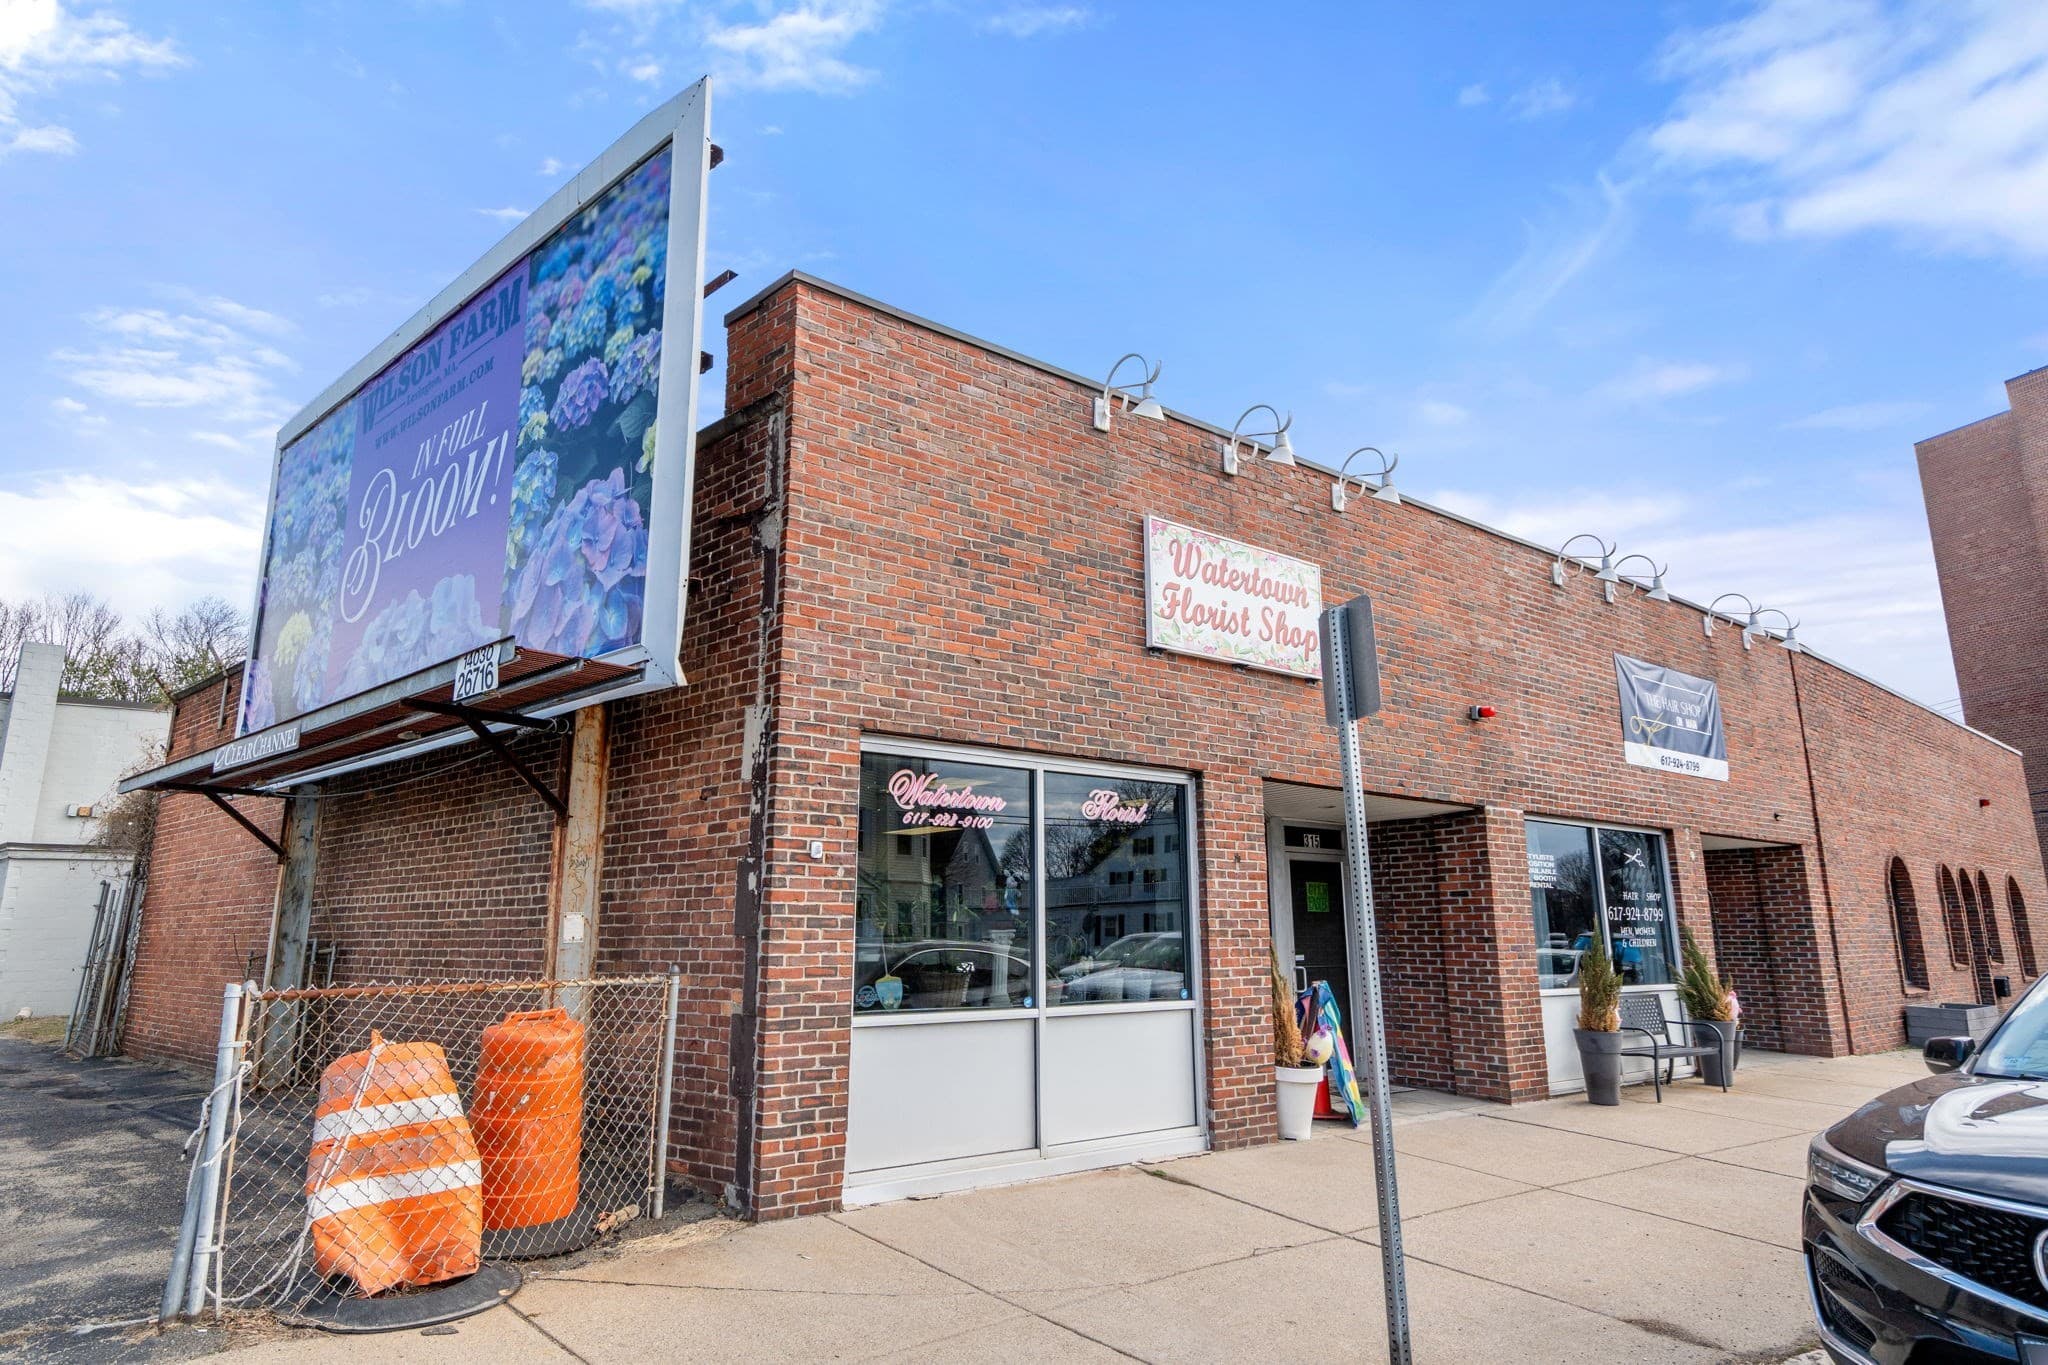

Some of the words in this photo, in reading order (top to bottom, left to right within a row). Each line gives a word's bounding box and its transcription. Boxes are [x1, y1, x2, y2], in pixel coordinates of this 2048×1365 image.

[362, 337, 444, 434] WILSON
[448, 275, 524, 361] FARM
[375, 356, 495, 449] WWW.WILSONFARM.COM
[411, 434, 437, 480] IN
[434, 400, 488, 466] FULL
[340, 430, 509, 623] BLOOM!
[1169, 538, 1309, 609] Watertown
[1160, 581, 1250, 638] Florist
[1258, 606, 1318, 662] Shop
[456, 661, 494, 698] 26716
[888, 769, 1007, 812] Watertown
[1081, 789, 1148, 823] Florist
[1303, 833, 1320, 848] 315
[1608, 906, 1664, 922] 617-924-8799
[1622, 891, 1639, 901] HAIR
[1646, 892, 1661, 902] SHOP
[1628, 938, 1657, 948] CHILDREN
